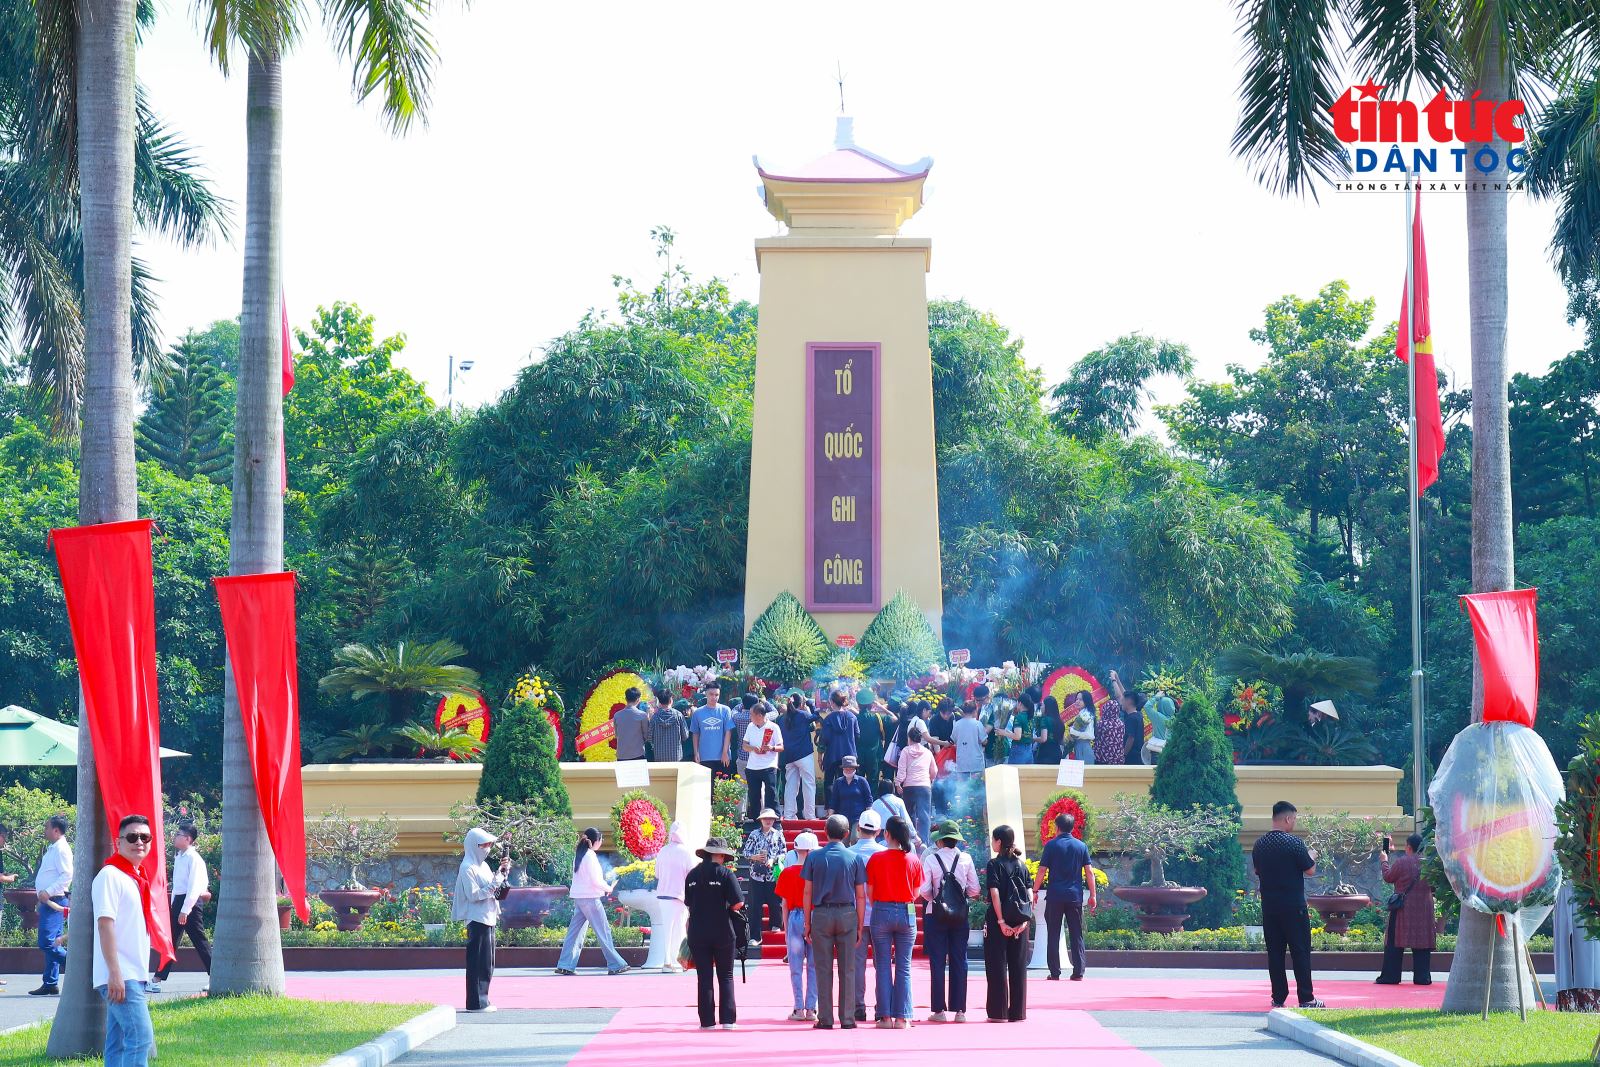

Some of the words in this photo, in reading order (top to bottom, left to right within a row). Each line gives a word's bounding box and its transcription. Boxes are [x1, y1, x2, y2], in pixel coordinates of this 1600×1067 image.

[834, 358, 853, 395] TỔ
[823, 422, 863, 461] QUỐC
[831, 495, 856, 522] GHI
[823, 553, 863, 585] CÔNG
